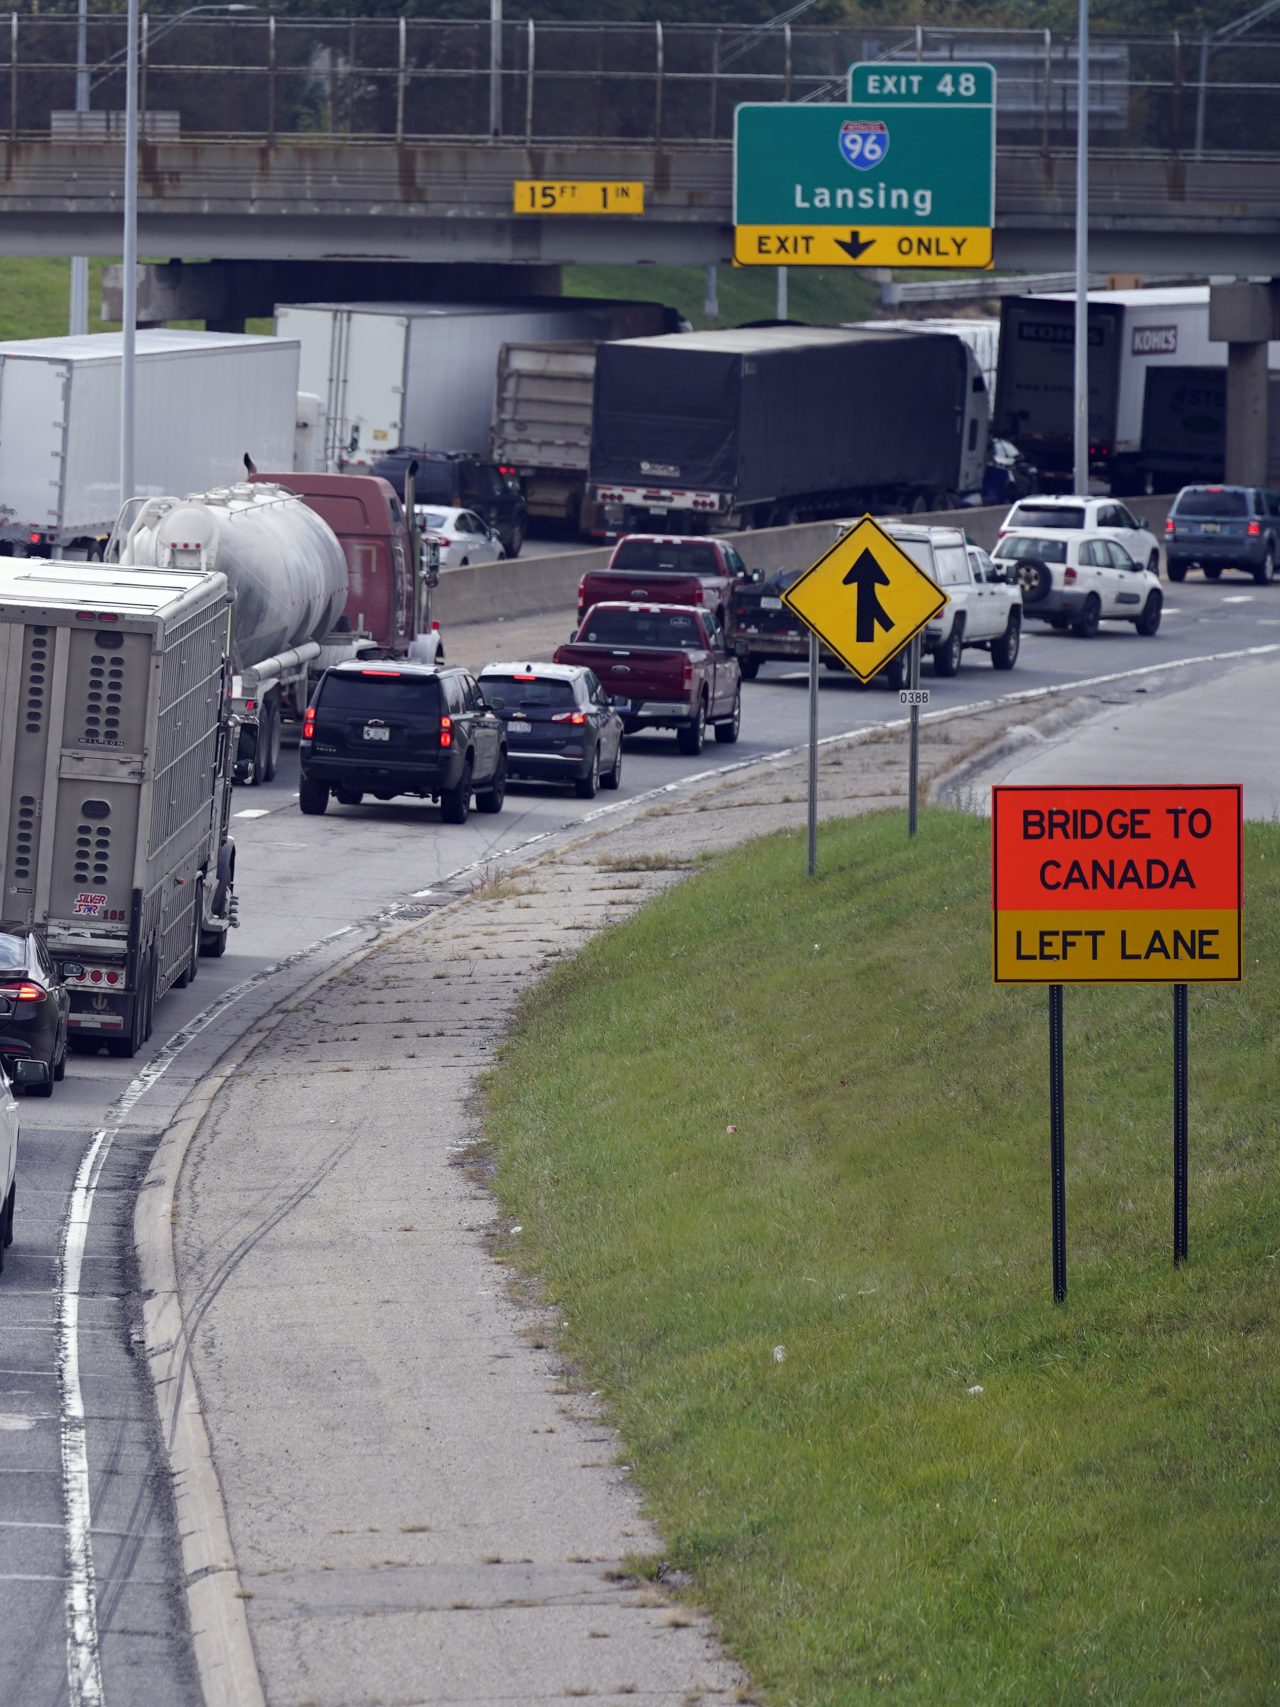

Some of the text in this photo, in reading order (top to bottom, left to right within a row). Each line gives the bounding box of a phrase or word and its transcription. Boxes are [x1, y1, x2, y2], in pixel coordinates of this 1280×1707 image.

[867, 75, 976, 96] EXIT 48
[844, 134, 882, 160] 96
[529, 186, 630, 209] 15 FT 1 IN
[795, 184, 933, 216] Lansing
[758, 236, 968, 256] EXIT ONLY
[1022, 324, 1101, 346] KOHS
[1134, 328, 1177, 351] KOHL'S
[78, 737, 125, 748] WILSON
[1022, 808, 1212, 840] BRIDGE TO
[1039, 859, 1196, 890] CANADA
[75, 893, 107, 905] SILVER
[102, 909, 126, 922] 185
[1016, 929, 1219, 960] LEFT LANE
